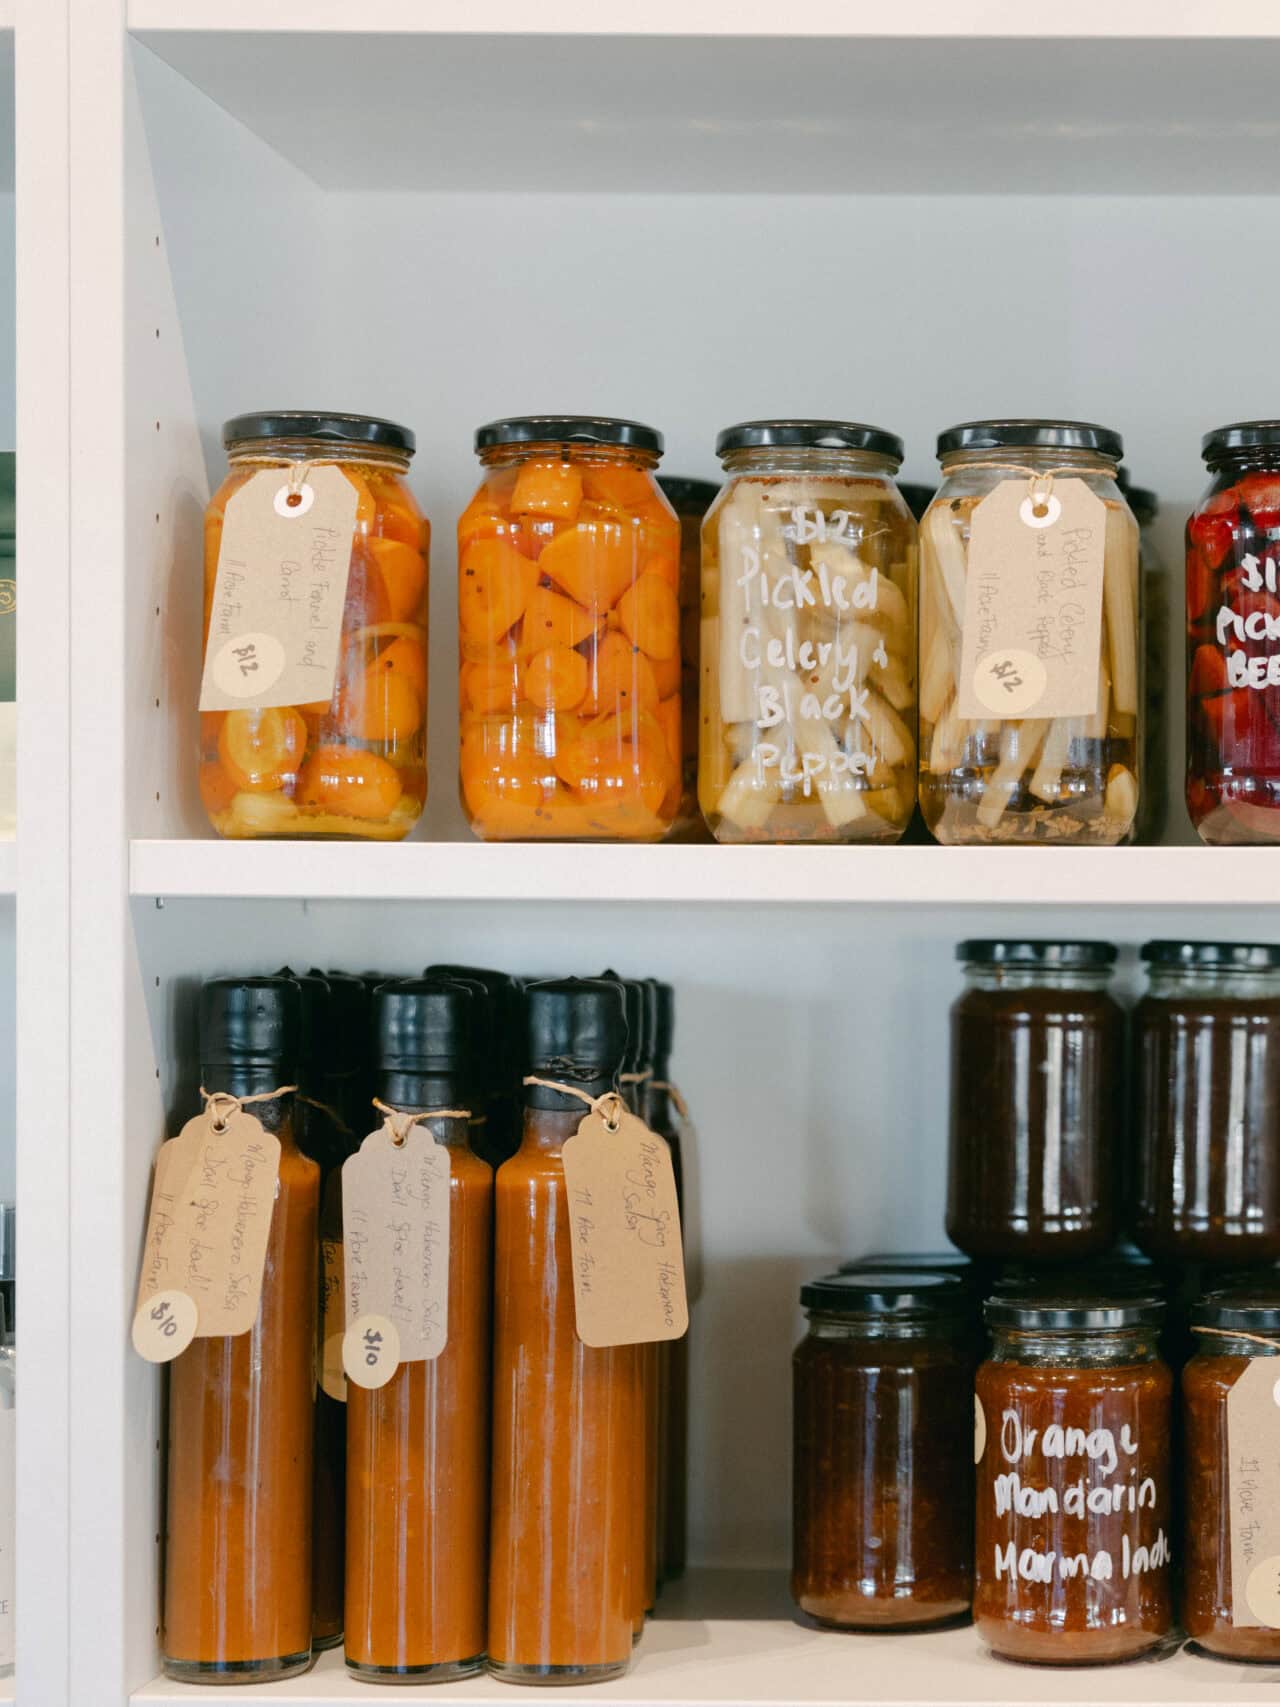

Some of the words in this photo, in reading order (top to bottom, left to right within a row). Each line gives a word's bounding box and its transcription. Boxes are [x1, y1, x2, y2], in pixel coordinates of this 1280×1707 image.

[790, 506, 858, 545] $12
[1036, 534, 1053, 558] and
[736, 545, 879, 613] Pickled
[1060, 528, 1096, 591] Pickled
[279, 561, 302, 611] Carrot
[232, 643, 259, 678] $12
[296, 641, 327, 671] and
[741, 625, 858, 692] Celery
[990, 660, 1023, 693] $12
[756, 679, 870, 729] Black
[752, 742, 879, 797] Pepper
[227, 1144, 267, 1189] Mango
[626, 1142, 660, 1199] Mango
[223, 1273, 251, 1311] Salsa
[150, 1302, 177, 1337] $10
[363, 1327, 383, 1367] $10
[1001, 1408, 1138, 1476] Orange
[994, 1467, 1156, 1520] Mandarin
